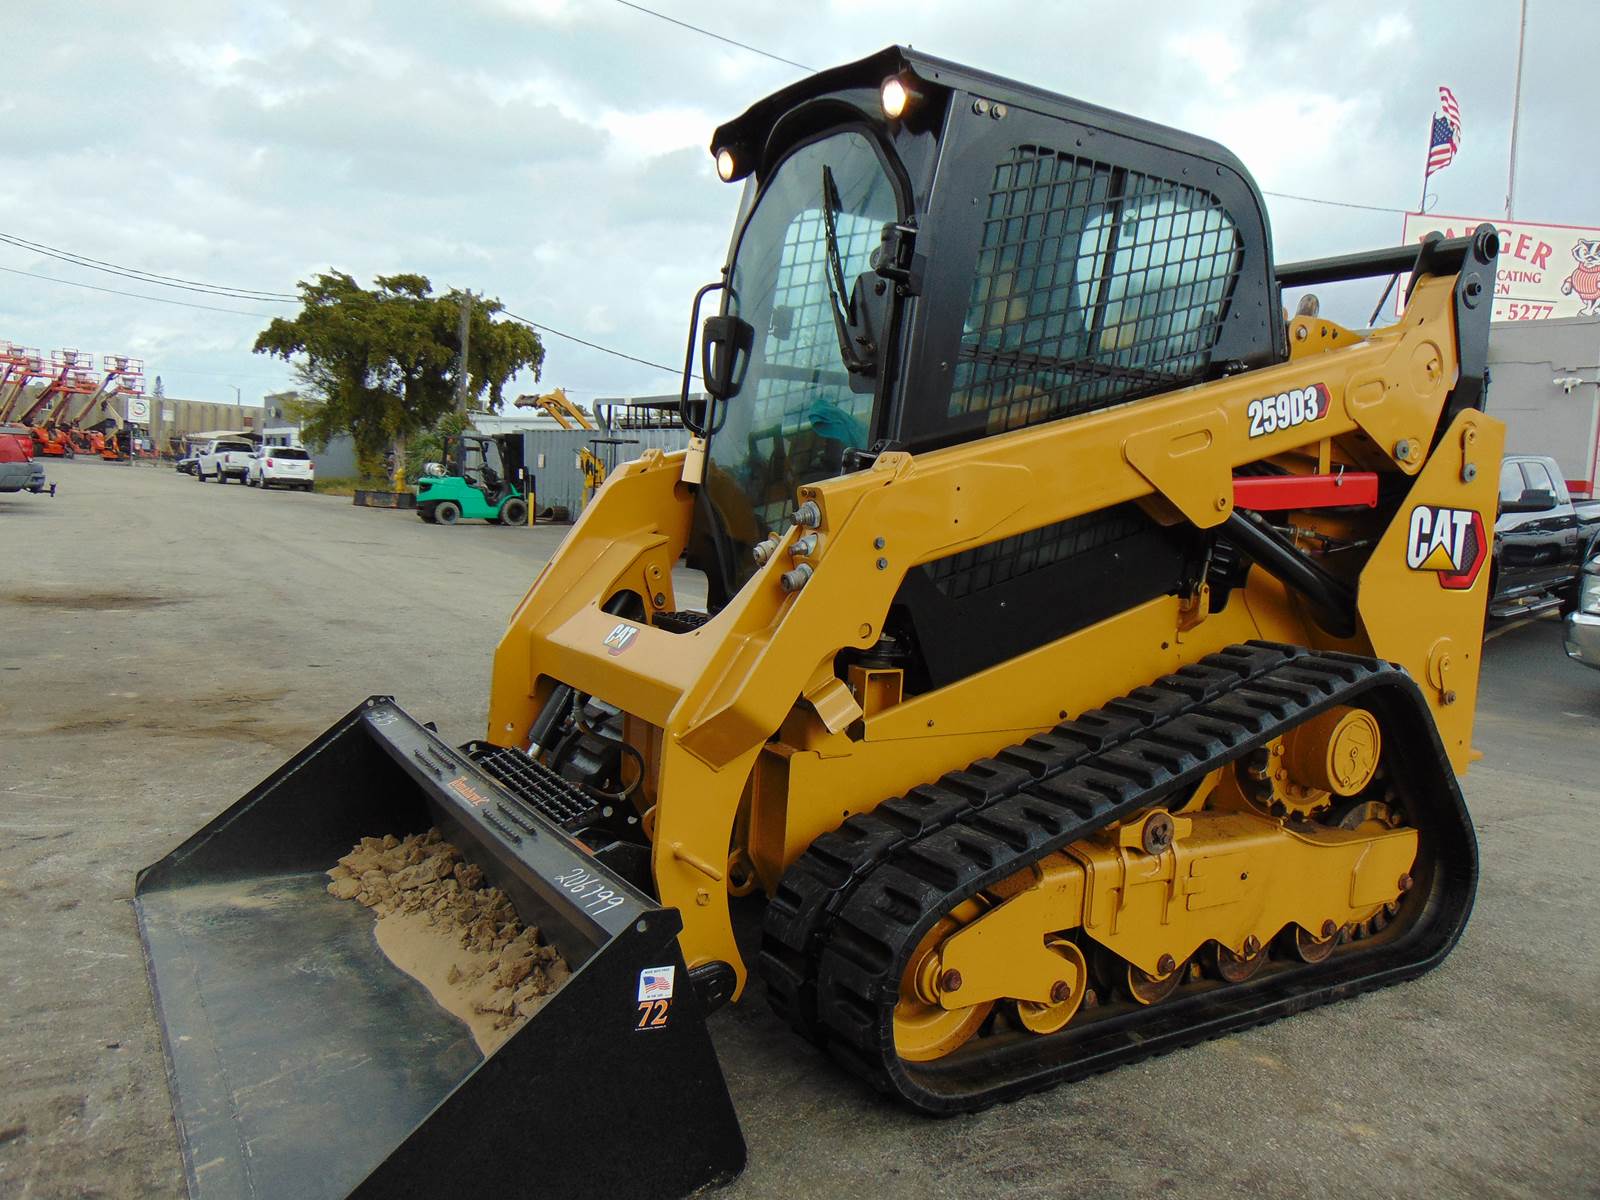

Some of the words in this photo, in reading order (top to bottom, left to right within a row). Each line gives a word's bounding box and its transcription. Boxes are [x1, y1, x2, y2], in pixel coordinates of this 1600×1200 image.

[1508, 303, 1553, 320] 5277
[1247, 385, 1319, 438] 259D3
[1407, 505, 1473, 571] CAT
[603, 623, 638, 649] CAT
